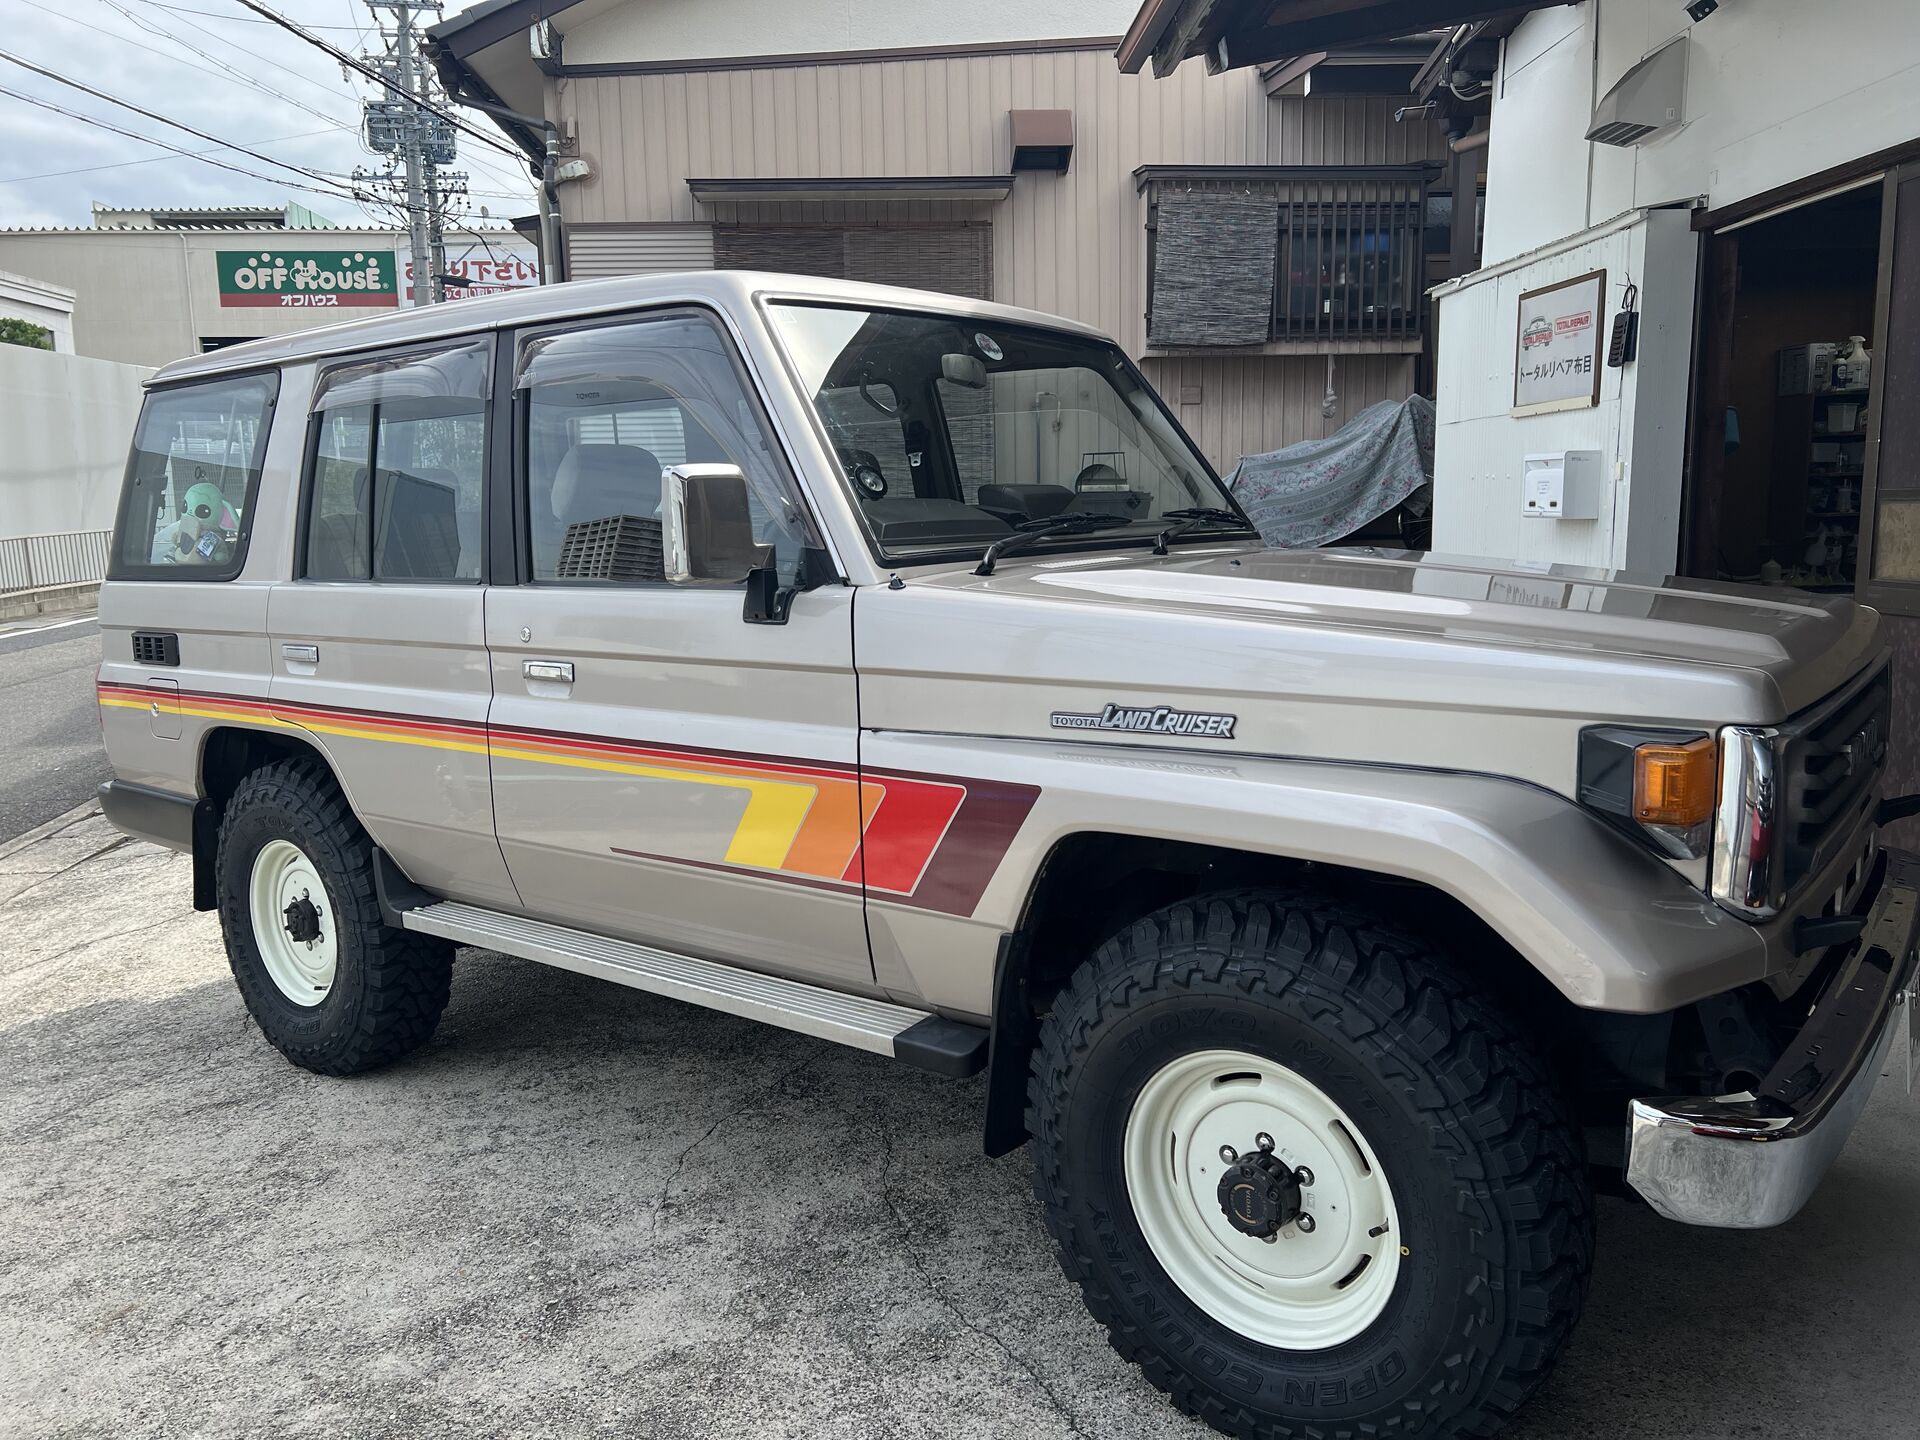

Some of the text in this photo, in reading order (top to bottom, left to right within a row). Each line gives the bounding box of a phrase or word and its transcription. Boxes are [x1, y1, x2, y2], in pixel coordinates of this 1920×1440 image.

[234, 260, 382, 290] OFF HOUSE
[405, 260, 537, 282] り下さい
[281, 294, 339, 307] オフハウス
[1519, 355, 1592, 383] トータルリペア布目
[1053, 716, 1097, 728] TOYOTA
[1283, 1346, 1407, 1408] OPEN
